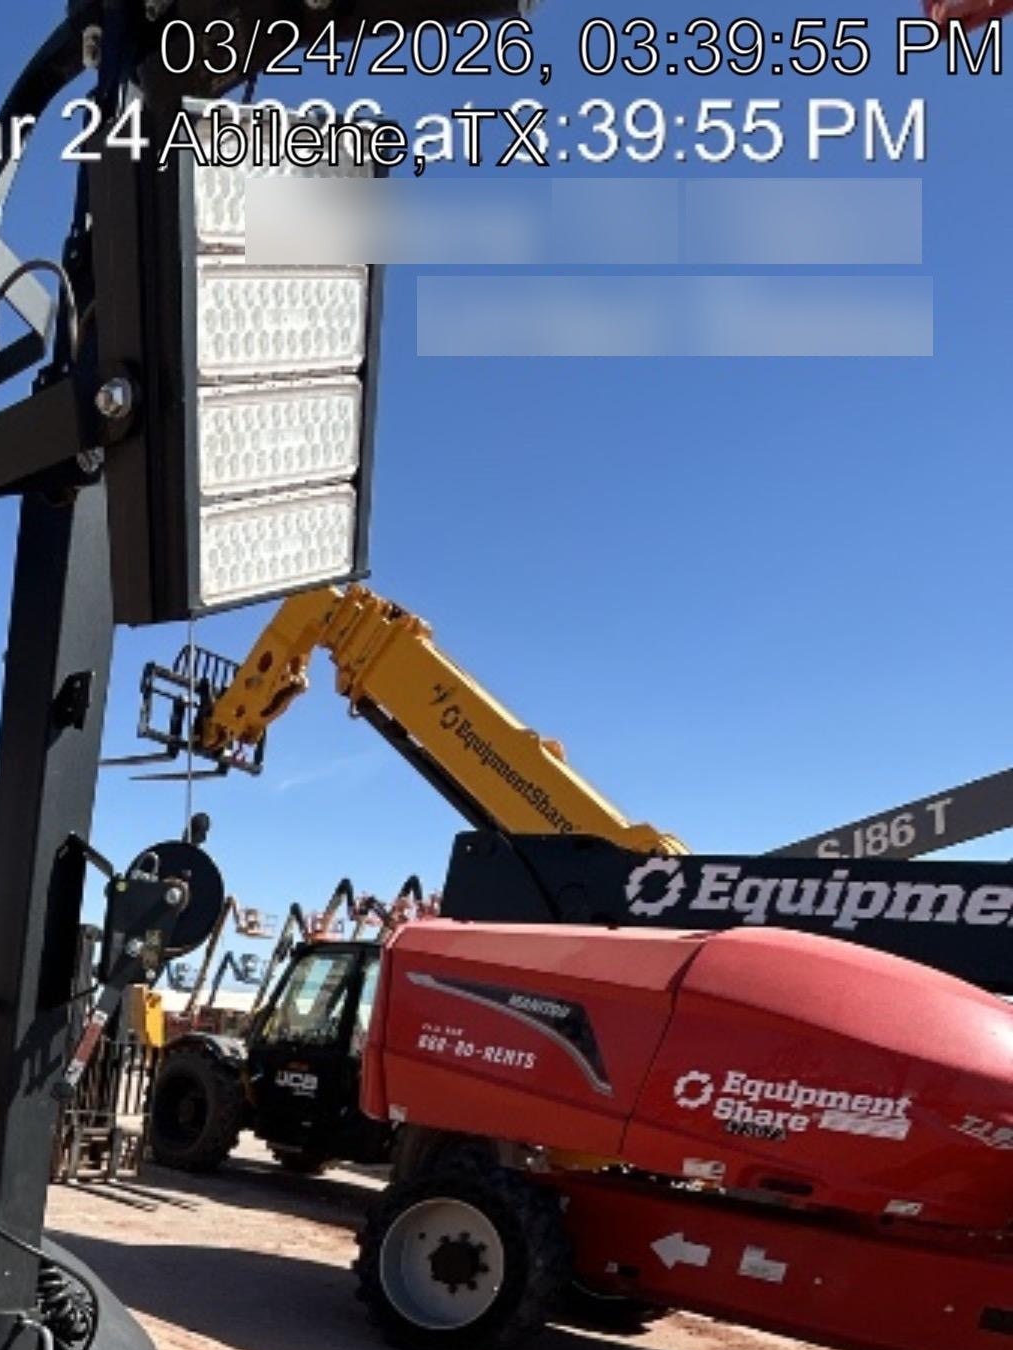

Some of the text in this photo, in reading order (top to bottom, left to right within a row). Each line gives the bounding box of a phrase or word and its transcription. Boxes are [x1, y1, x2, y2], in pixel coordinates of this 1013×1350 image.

[454, 719, 574, 834] EquipmentShare
[925, 797, 953, 836] T
[688, 862, 1013, 931] Equipme
[275, 1071, 318, 1091] JCB
[722, 1070, 912, 1117] Equipment
[713, 1097, 810, 1133] Share
